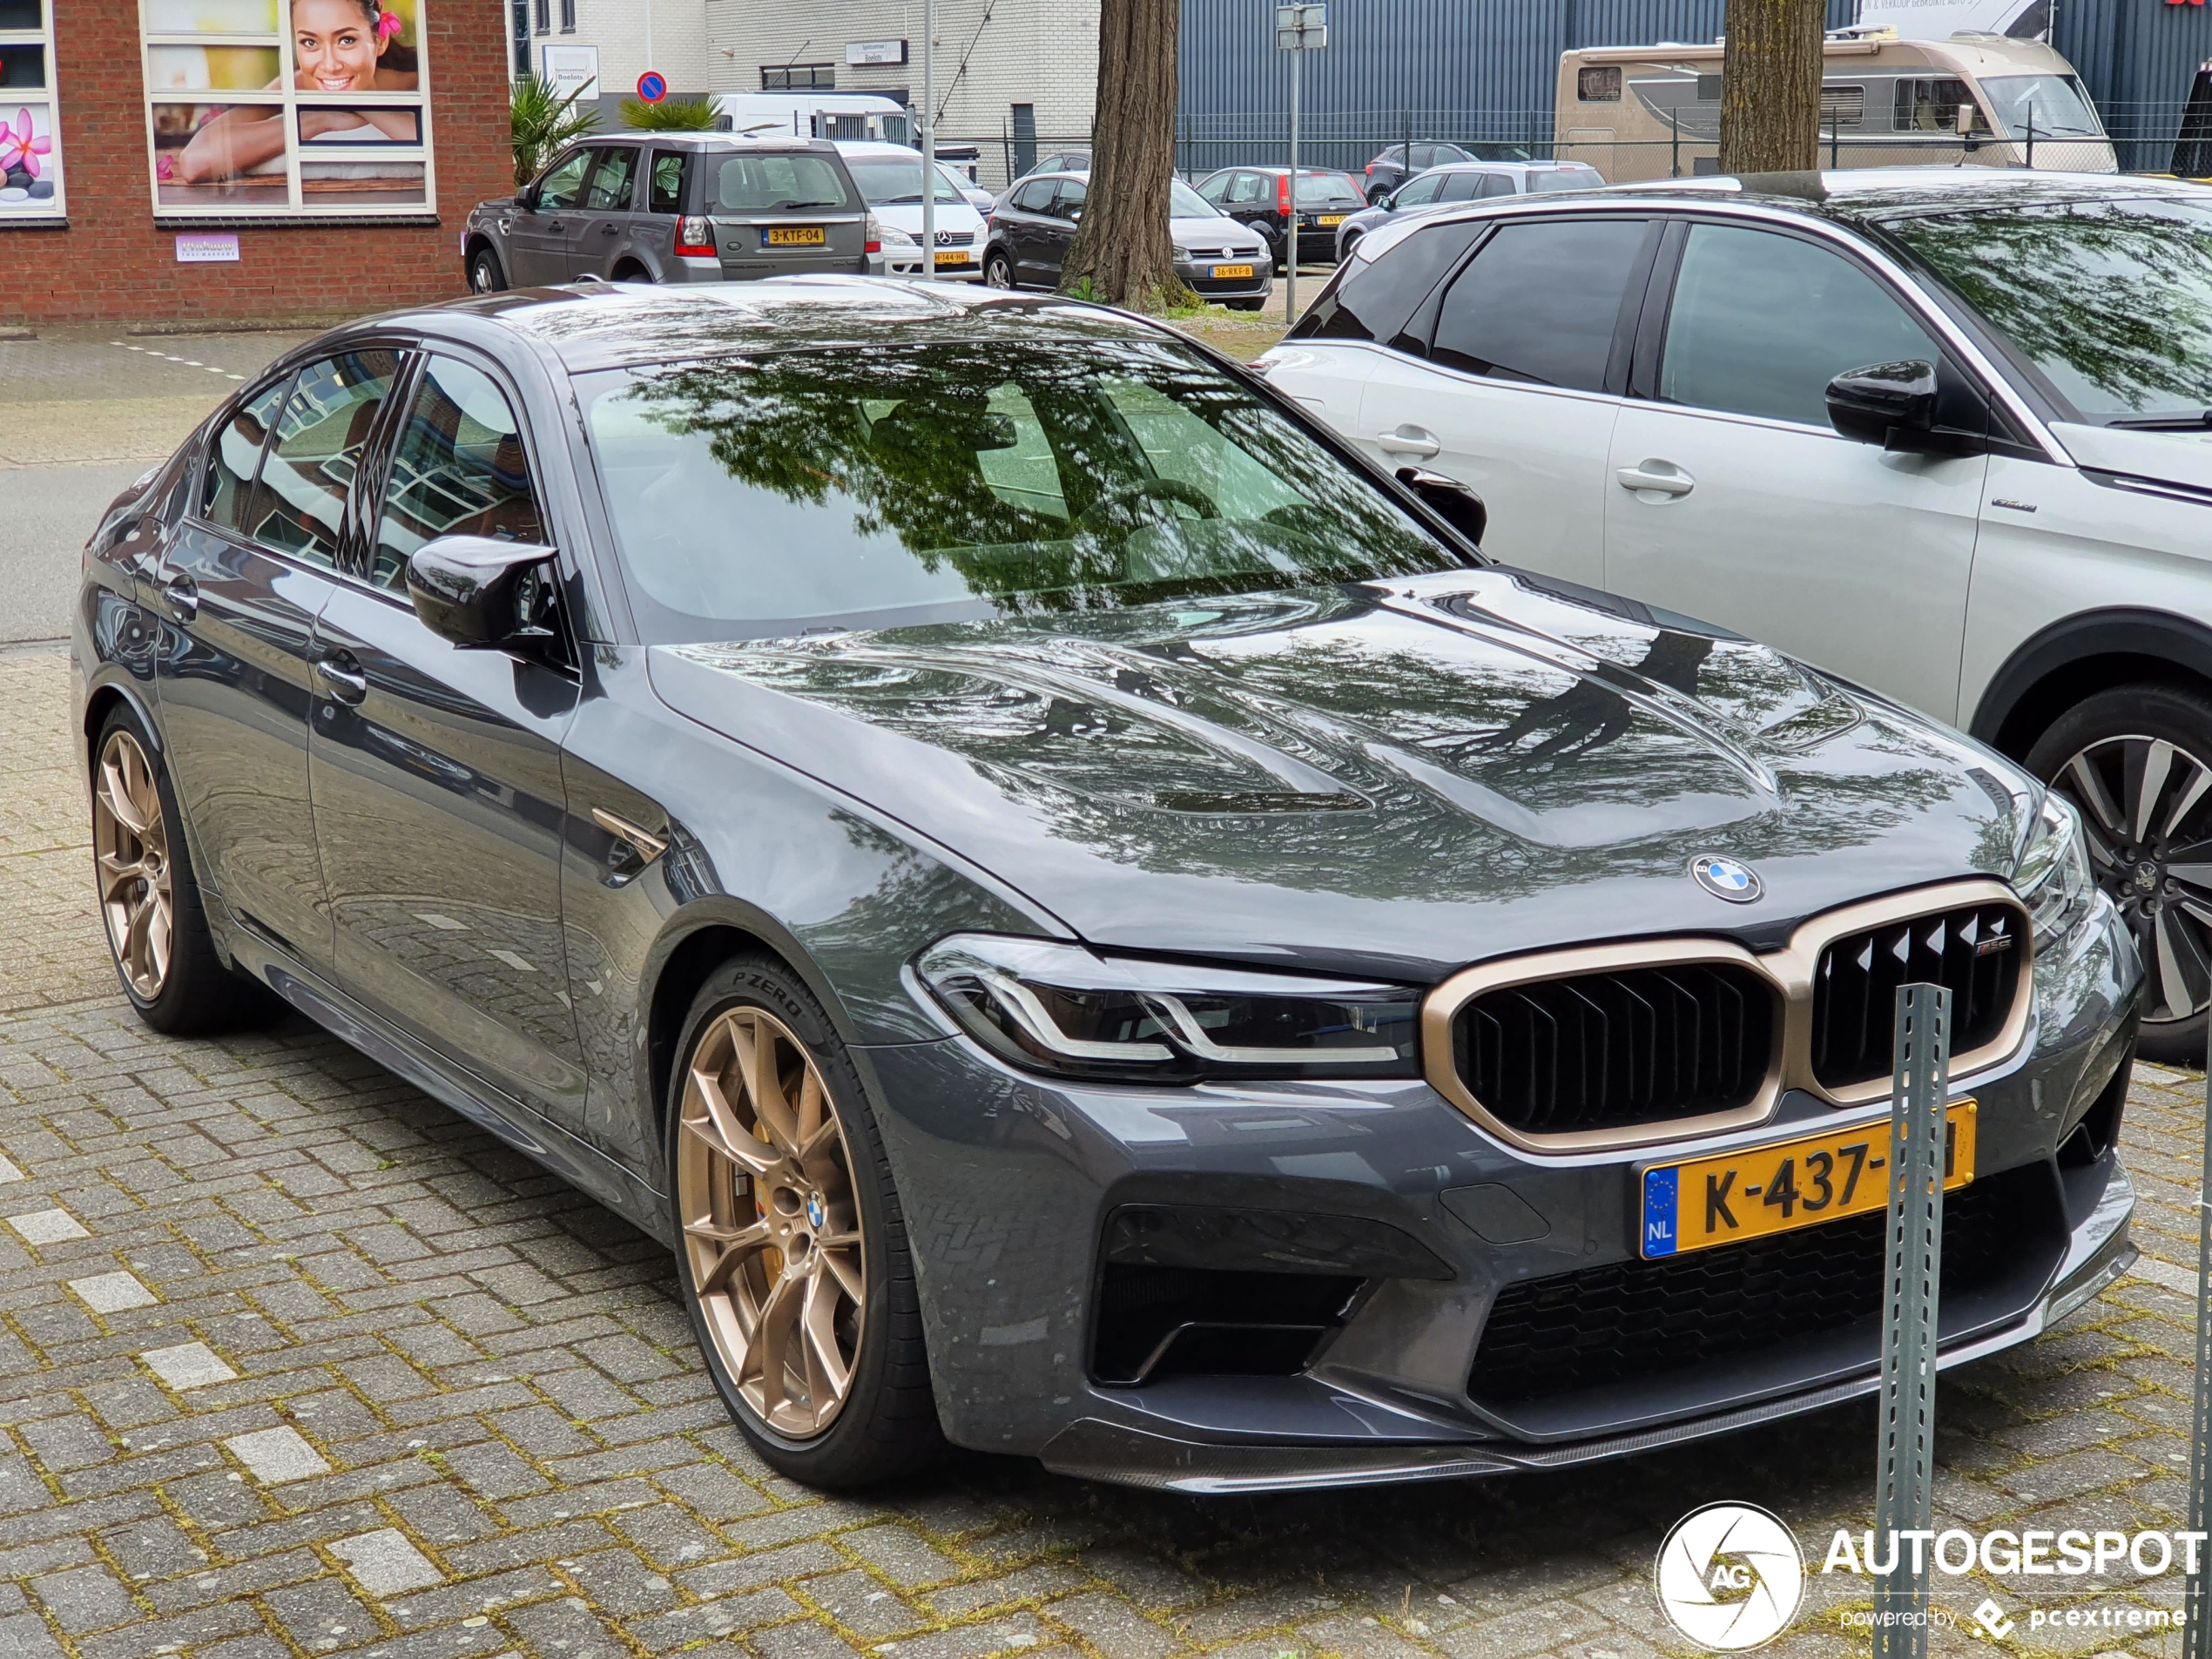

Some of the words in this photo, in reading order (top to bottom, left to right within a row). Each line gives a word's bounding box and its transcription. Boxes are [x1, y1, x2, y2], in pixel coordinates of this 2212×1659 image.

[772, 229, 819, 241] 3-KTF-04
[1216, 266, 1251, 276] 36-RKF-8
[732, 972, 746, 985] P
[747, 974, 802, 1018] ZERO
[1649, 1222, 1672, 1242] NL
